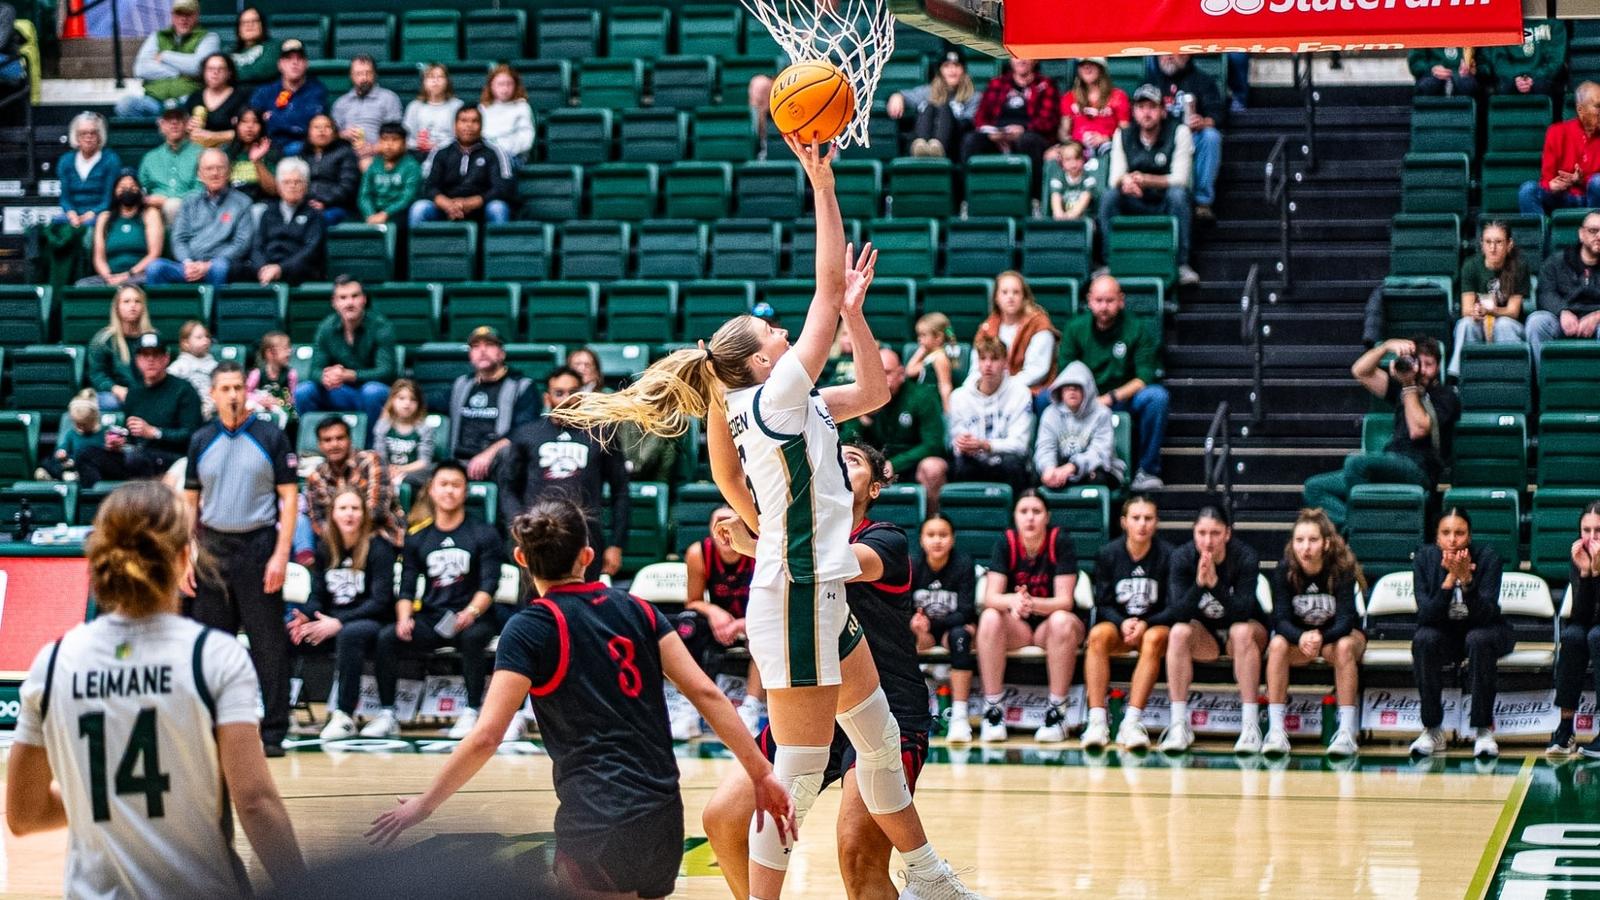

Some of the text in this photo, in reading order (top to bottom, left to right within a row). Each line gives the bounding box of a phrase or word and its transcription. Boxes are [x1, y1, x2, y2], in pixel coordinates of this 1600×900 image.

[72, 665, 173, 700] LEIMANE
[607, 634, 643, 698] 3
[1368, 690, 1419, 710] Peder
[1495, 700, 1551, 714] ersen
[78, 705, 171, 823] 14
